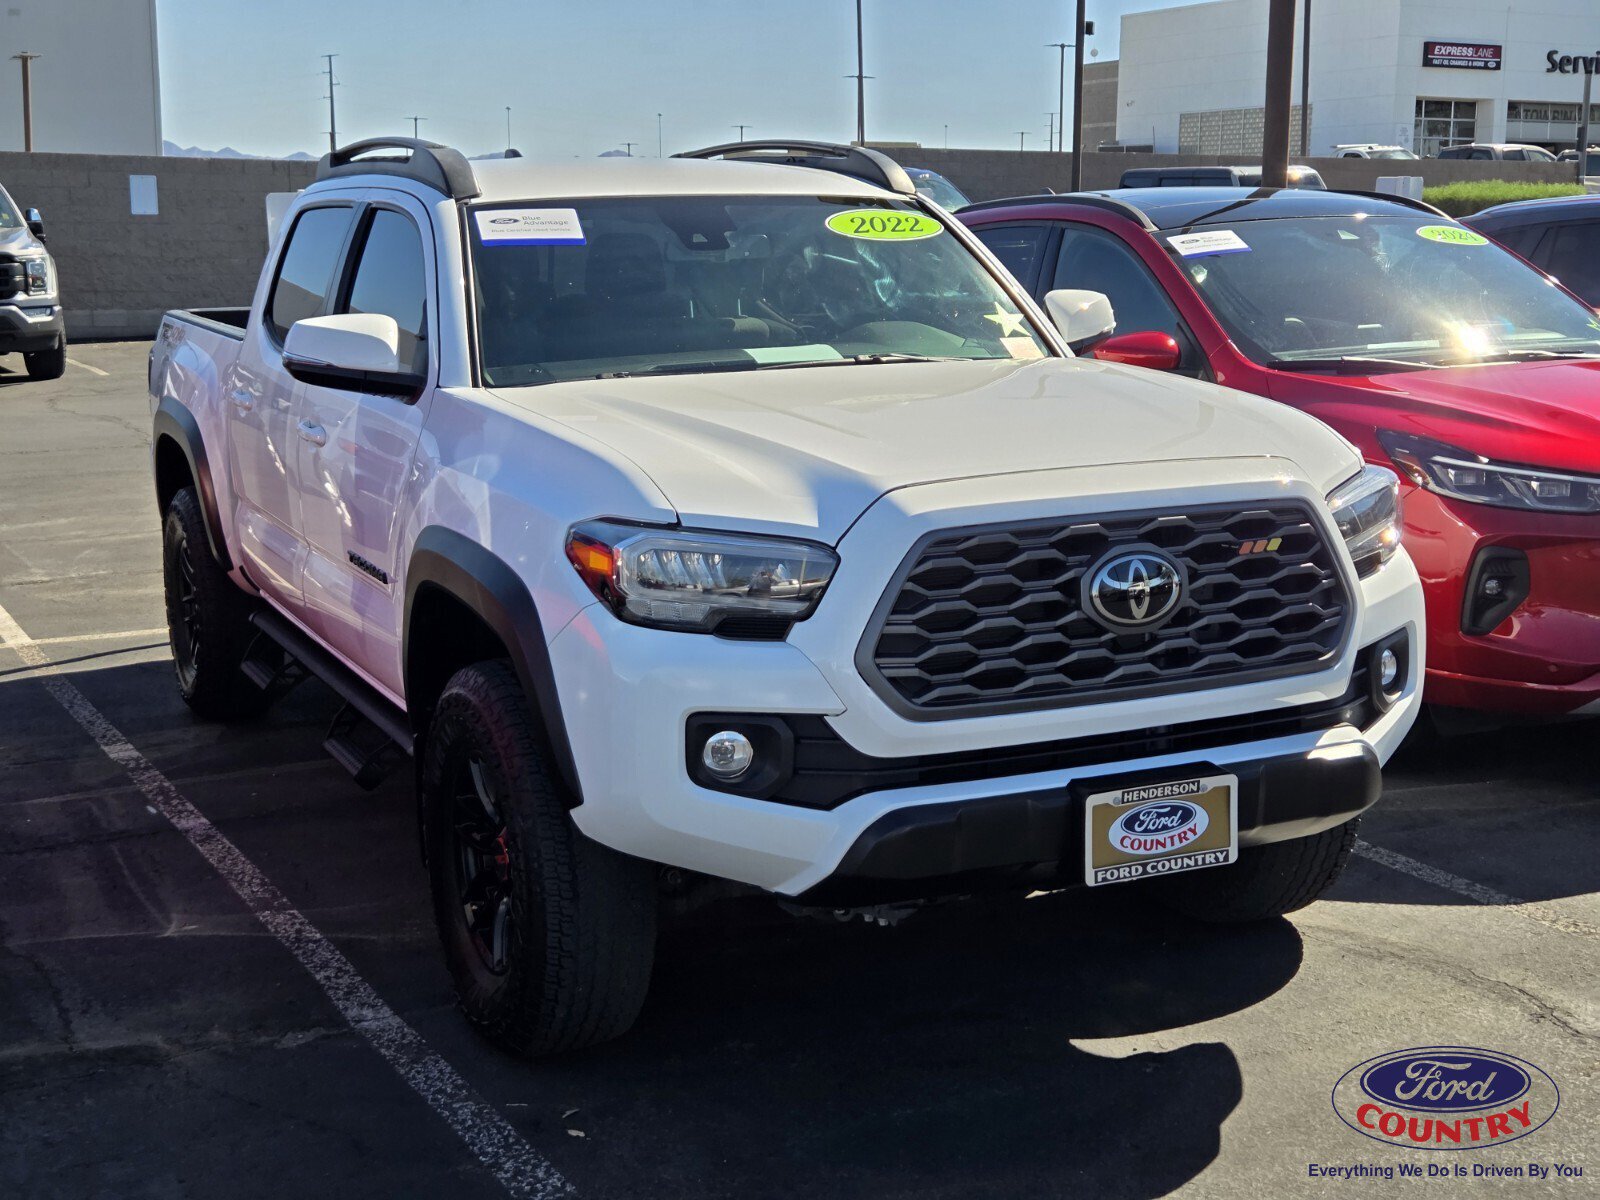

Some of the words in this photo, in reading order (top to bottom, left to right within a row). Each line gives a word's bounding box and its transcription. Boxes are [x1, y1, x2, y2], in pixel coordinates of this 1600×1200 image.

[1546, 49, 1600, 74] Servi
[850, 216, 924, 234] 2022
[1123, 783, 1199, 803] HENDERSON
[1134, 806, 1182, 832] Ford
[1120, 823, 1199, 851] COUNTRY
[1097, 865, 1142, 882] FORD
[1146, 851, 1228, 874] COUNTRY
